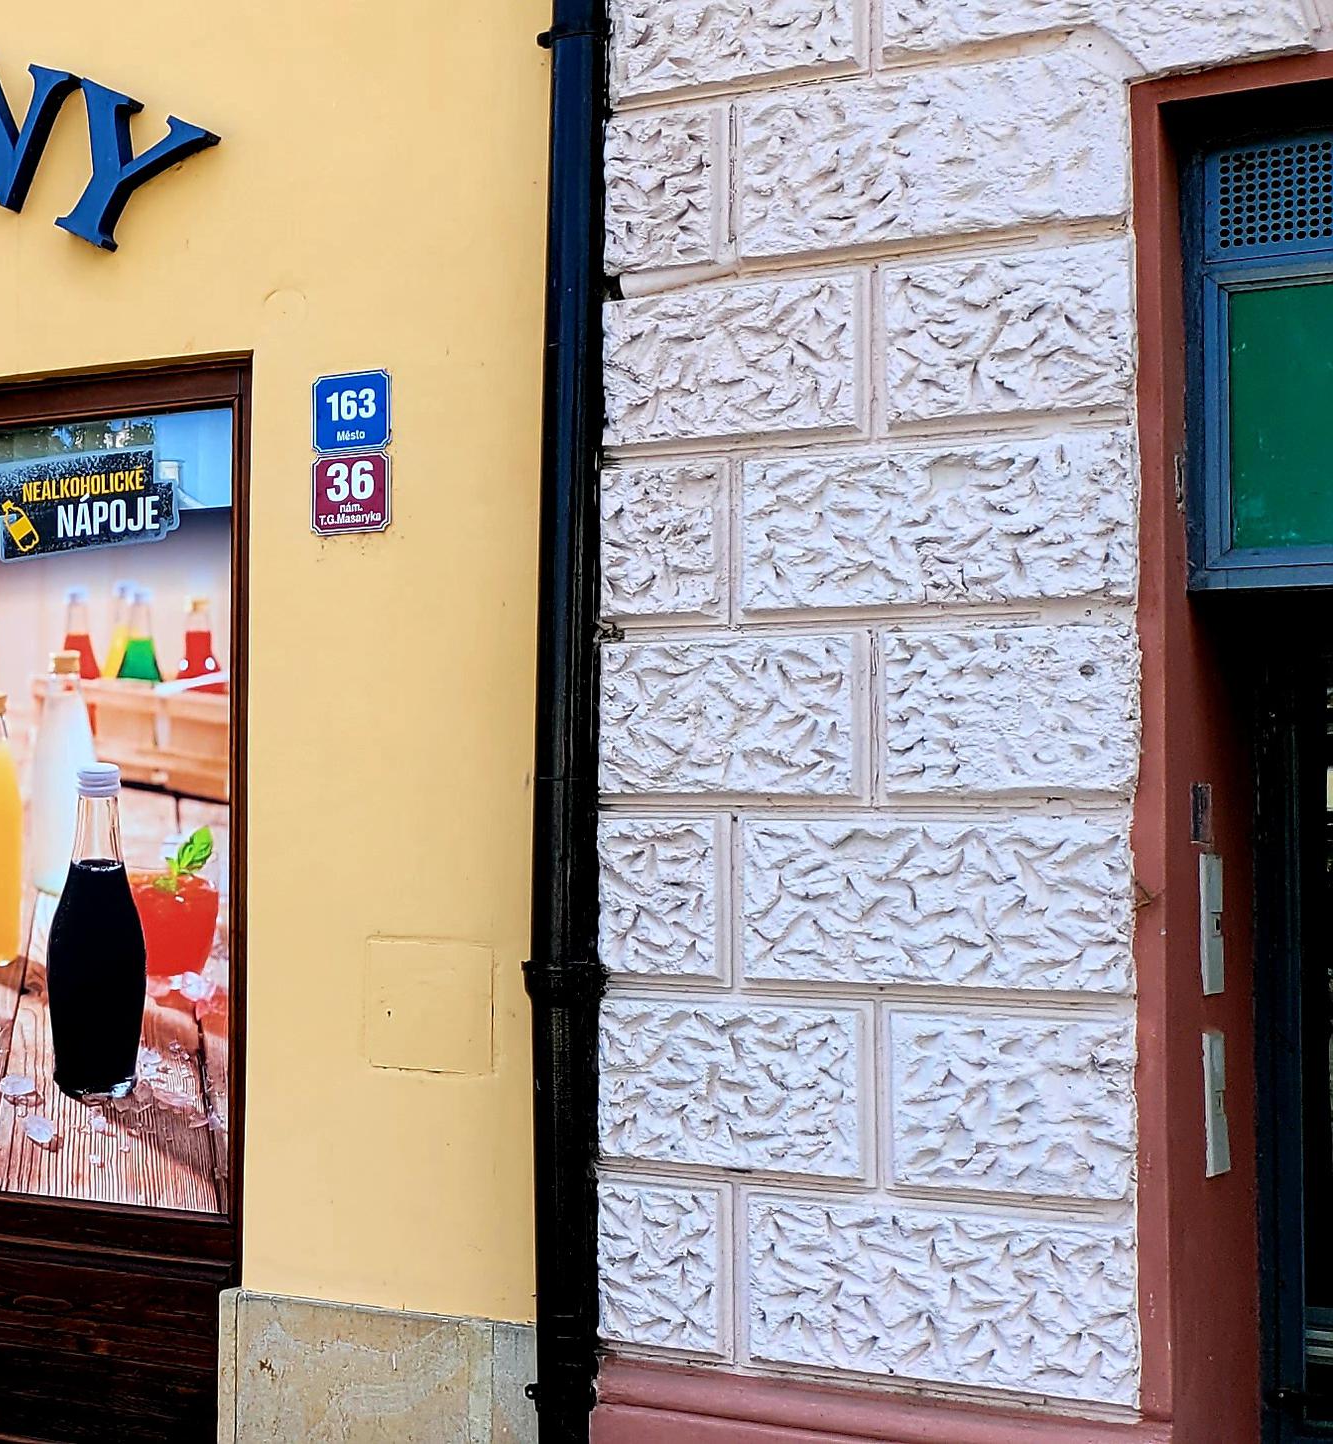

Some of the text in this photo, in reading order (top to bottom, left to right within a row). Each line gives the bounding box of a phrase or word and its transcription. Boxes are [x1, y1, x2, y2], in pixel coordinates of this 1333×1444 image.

[326, 388, 376, 421] 163
[336, 430, 366, 442] Město
[22, 466, 146, 503] NEALKOHOLICKÉ
[326, 460, 374, 502] 36
[57, 493, 160, 539] NÁPOJE
[339, 501, 363, 513] nám.
